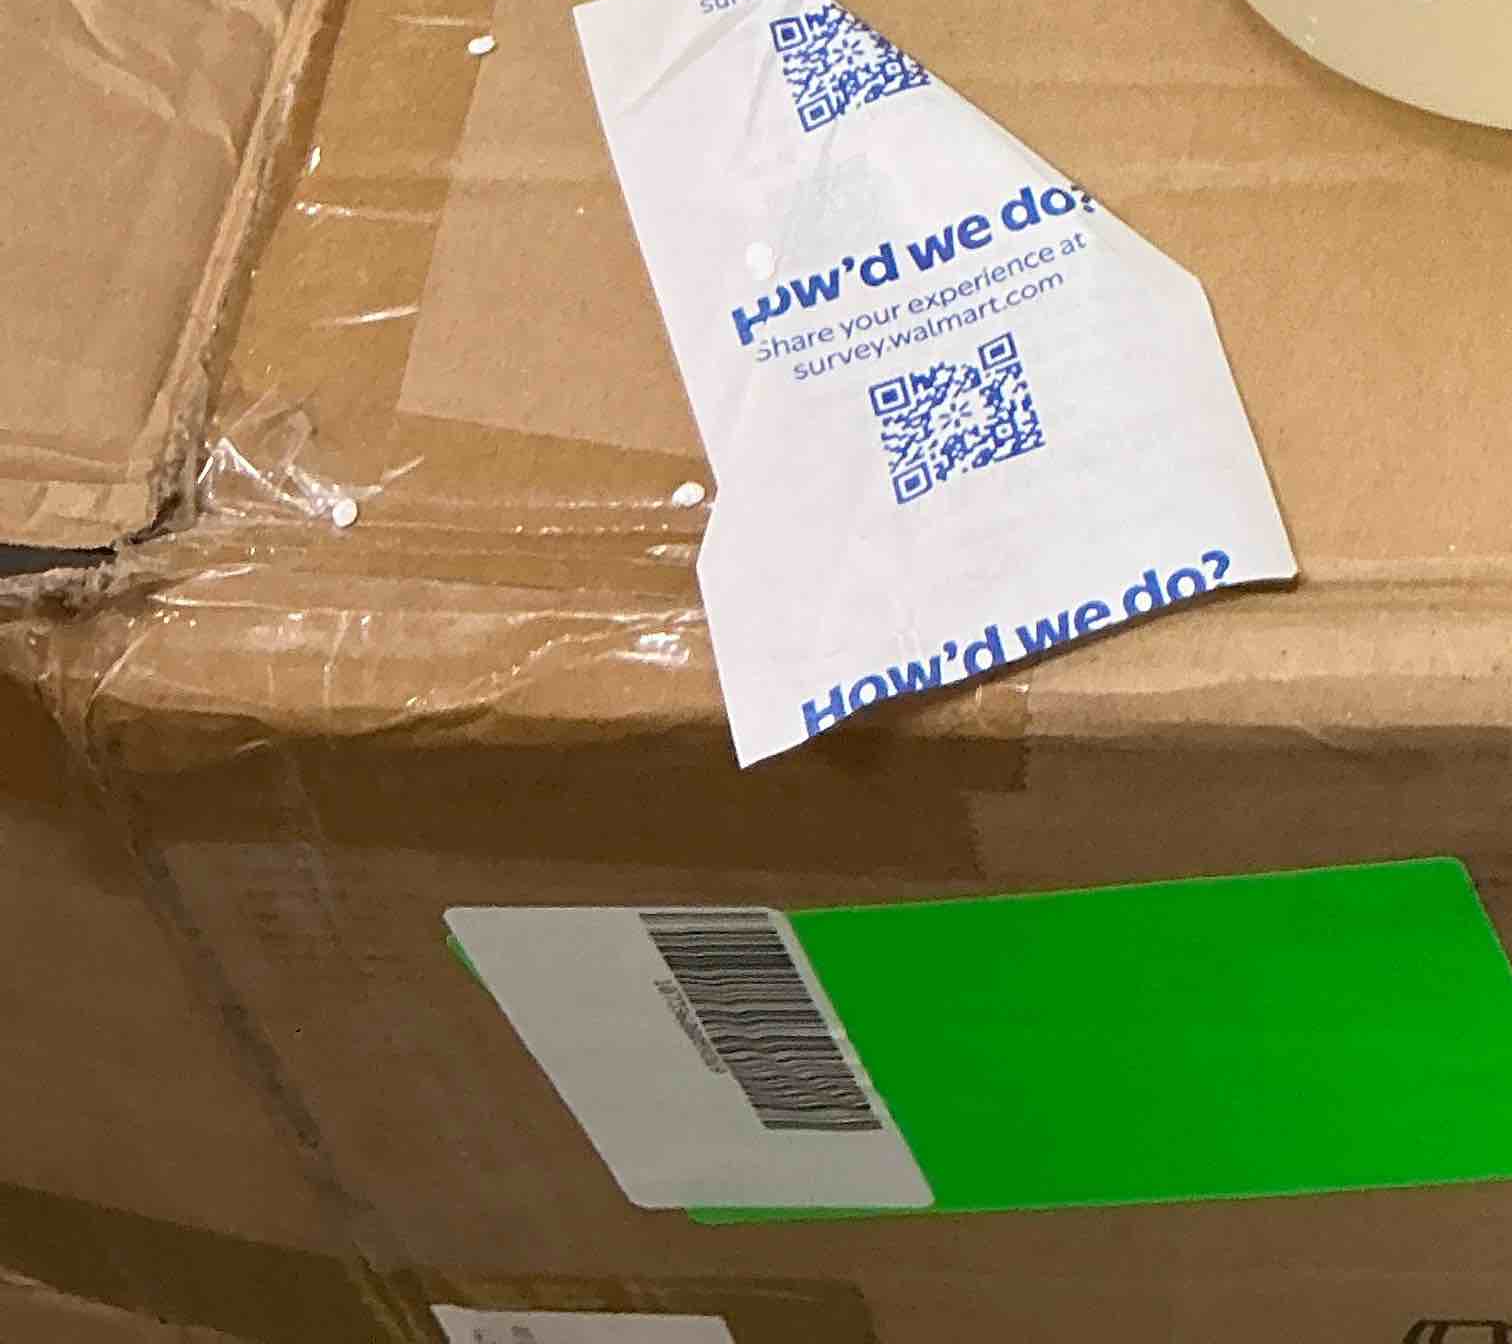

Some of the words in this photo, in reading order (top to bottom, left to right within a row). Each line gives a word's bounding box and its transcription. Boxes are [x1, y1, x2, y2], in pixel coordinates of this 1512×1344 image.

[757, 325, 834, 362] Share
[839, 303, 901, 341] your
[908, 246, 1056, 314] experience
[1060, 231, 1087, 257] at
[906, 213, 993, 272] we
[793, 269, 1065, 382] survey.walmart.com
[801, 624, 1006, 736] How'd
[1015, 599, 1112, 655] we
[1122, 549, 1230, 618] do?
